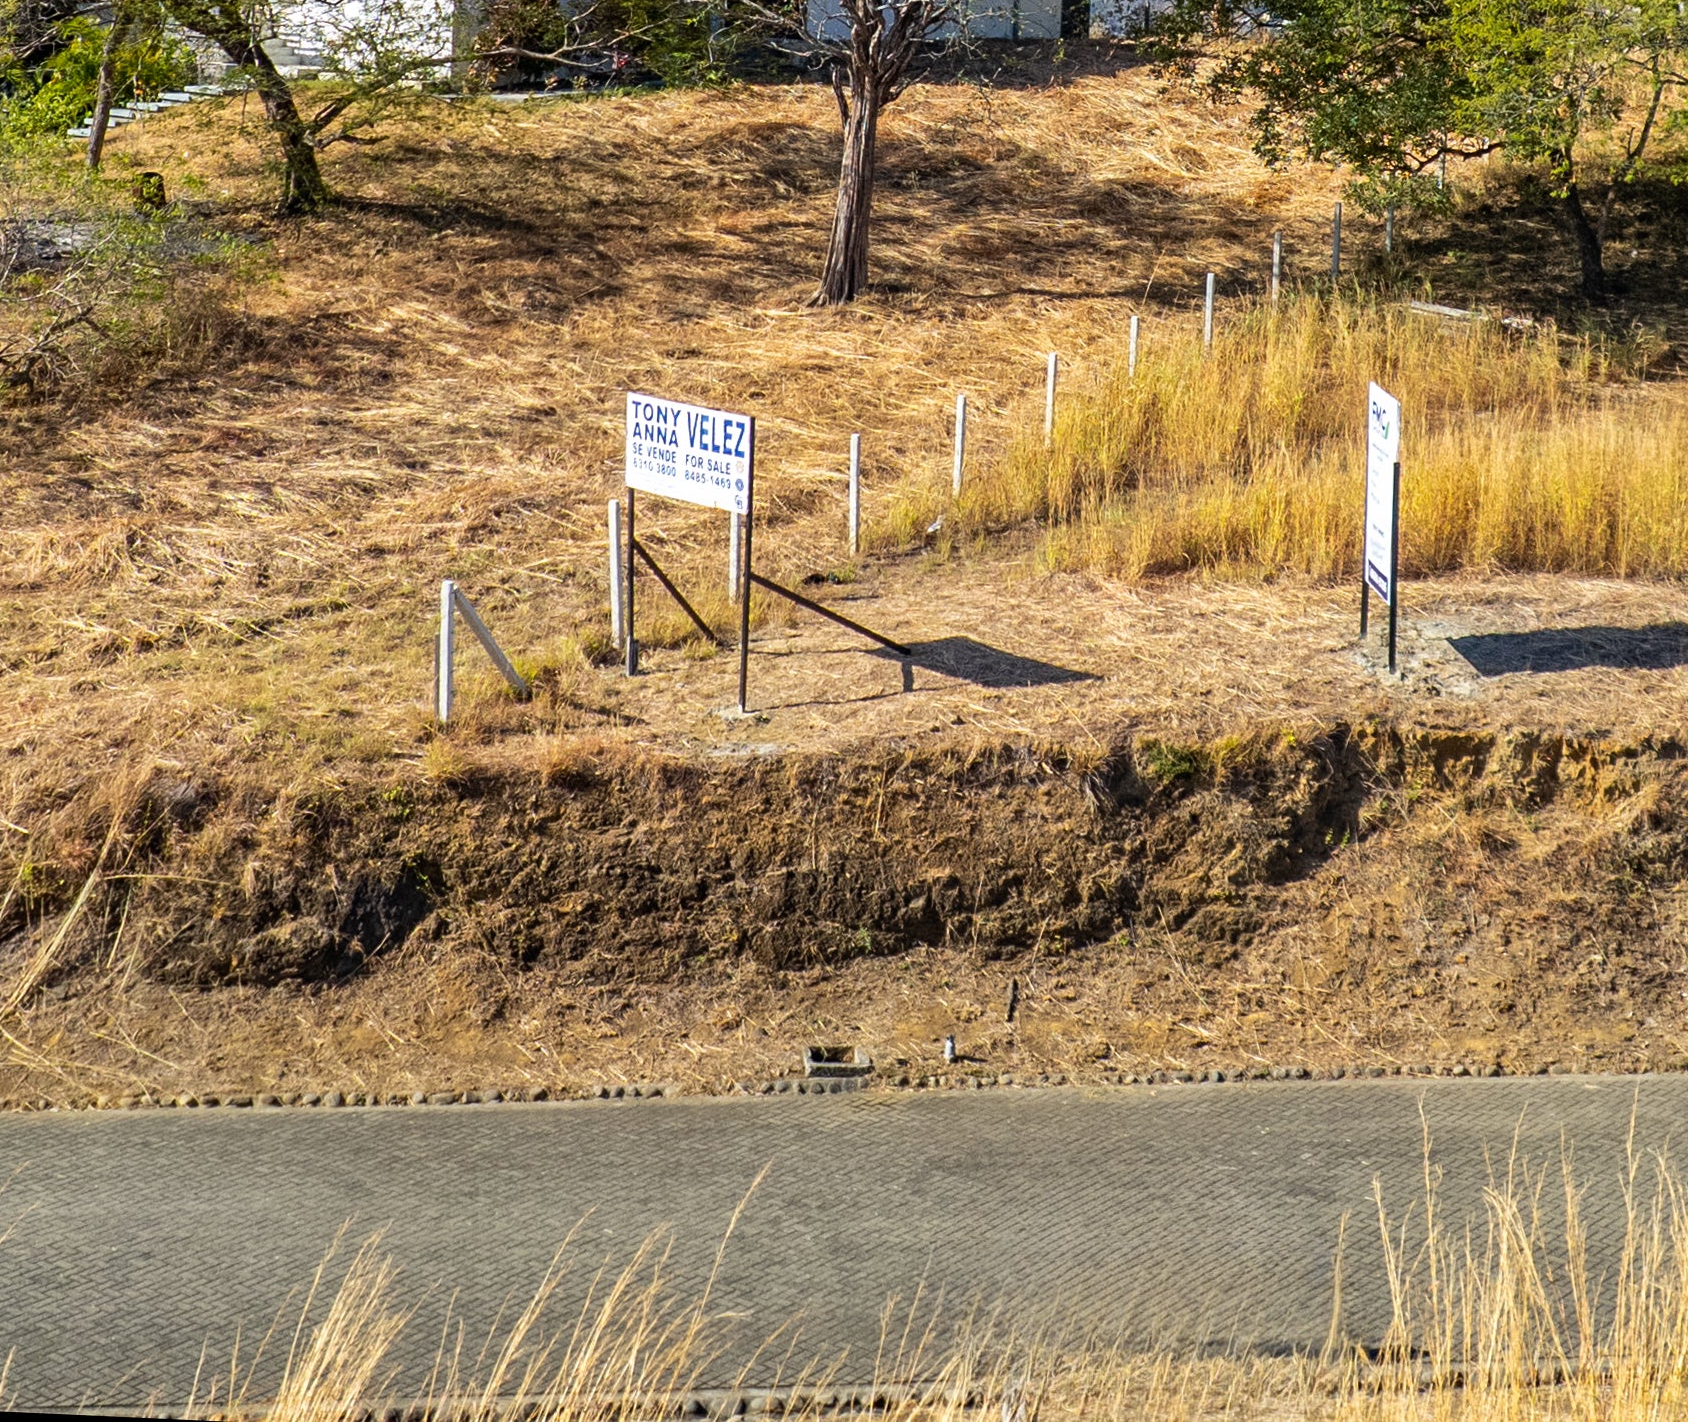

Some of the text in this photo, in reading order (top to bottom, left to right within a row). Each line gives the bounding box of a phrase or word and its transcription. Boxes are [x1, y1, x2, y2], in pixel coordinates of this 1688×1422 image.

[632, 400, 681, 427] TONY
[632, 422, 679, 448] ANNA
[687, 411, 745, 458] VELEZ
[632, 442, 677, 464] SE VENDE
[685, 454, 731, 475] FOR SALE
